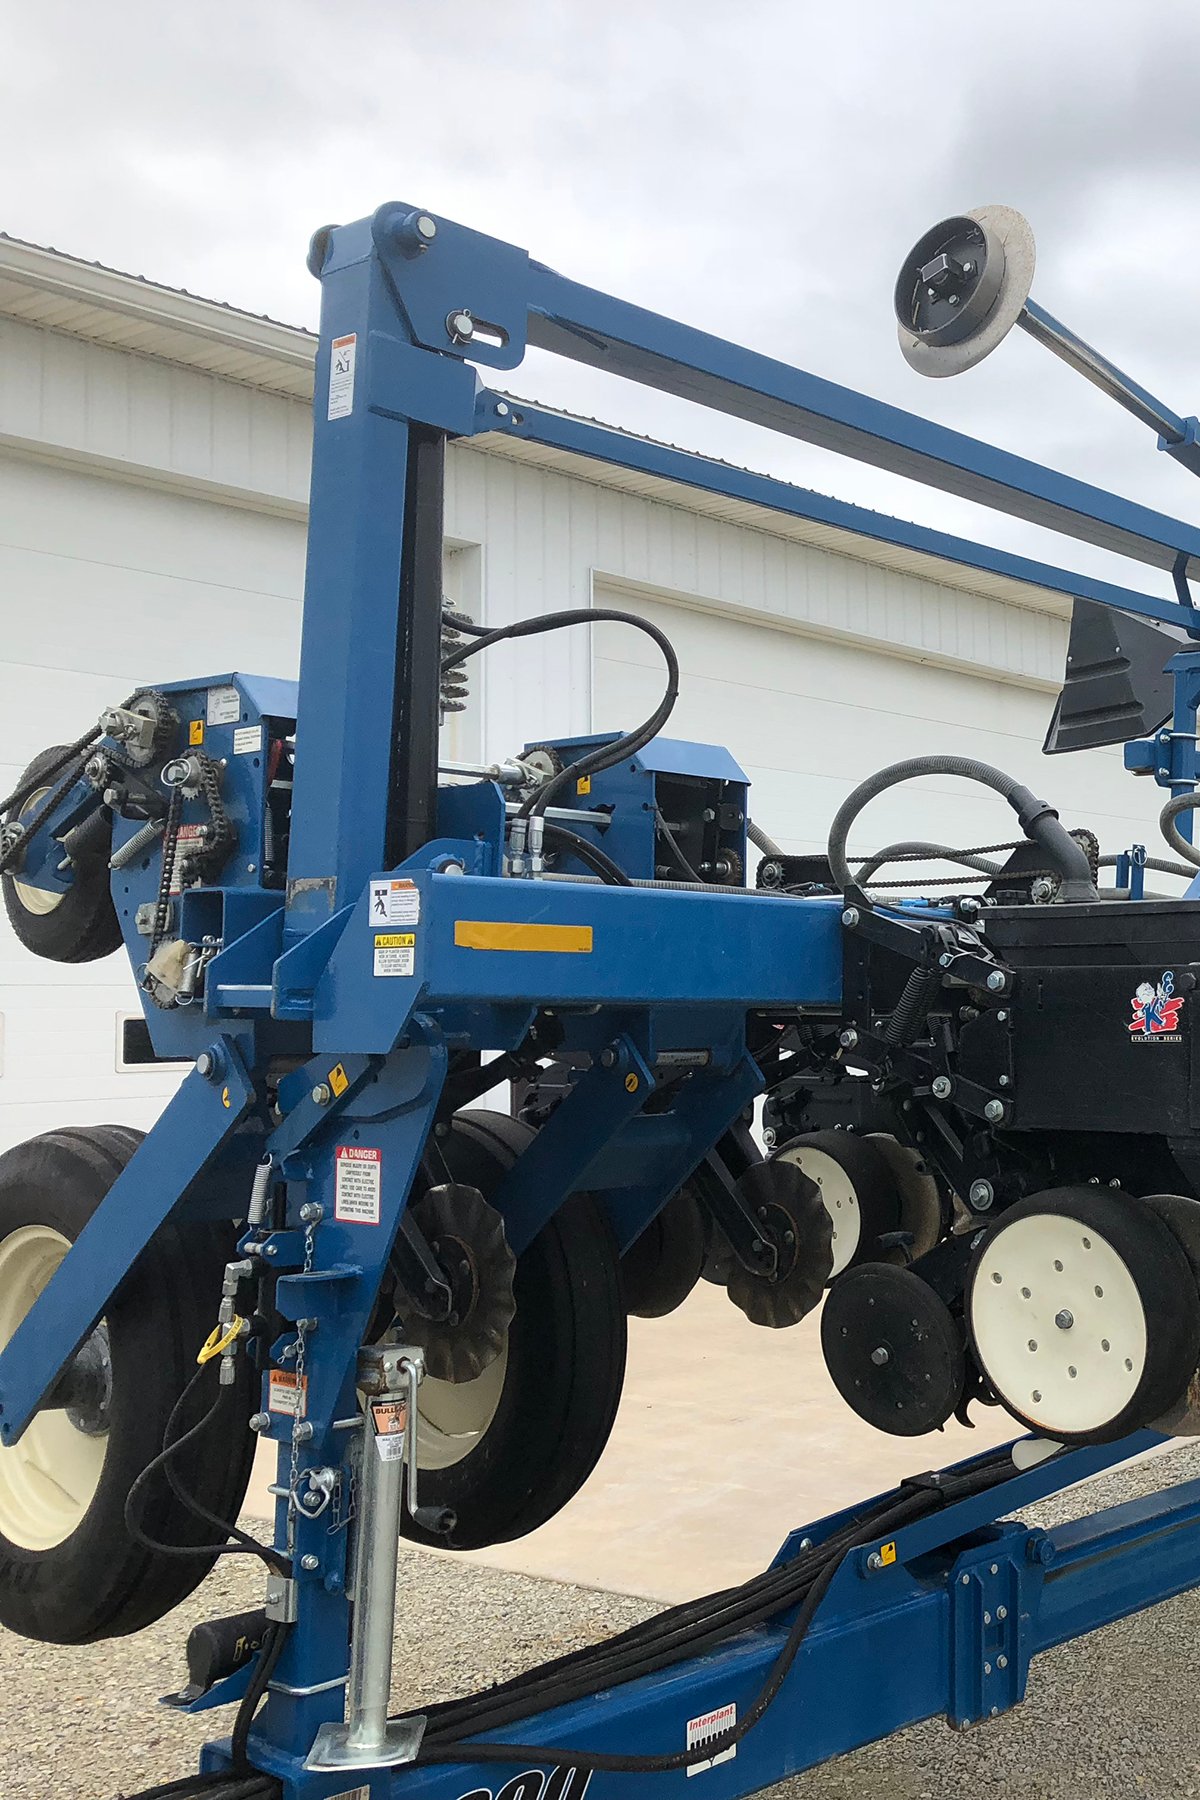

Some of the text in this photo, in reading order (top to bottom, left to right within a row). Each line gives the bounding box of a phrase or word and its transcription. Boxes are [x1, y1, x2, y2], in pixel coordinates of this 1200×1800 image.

[382, 936, 407, 945] CAUTION
[349, 1148, 377, 1160] DANGER
[689, 1706, 734, 1731] Interplant
